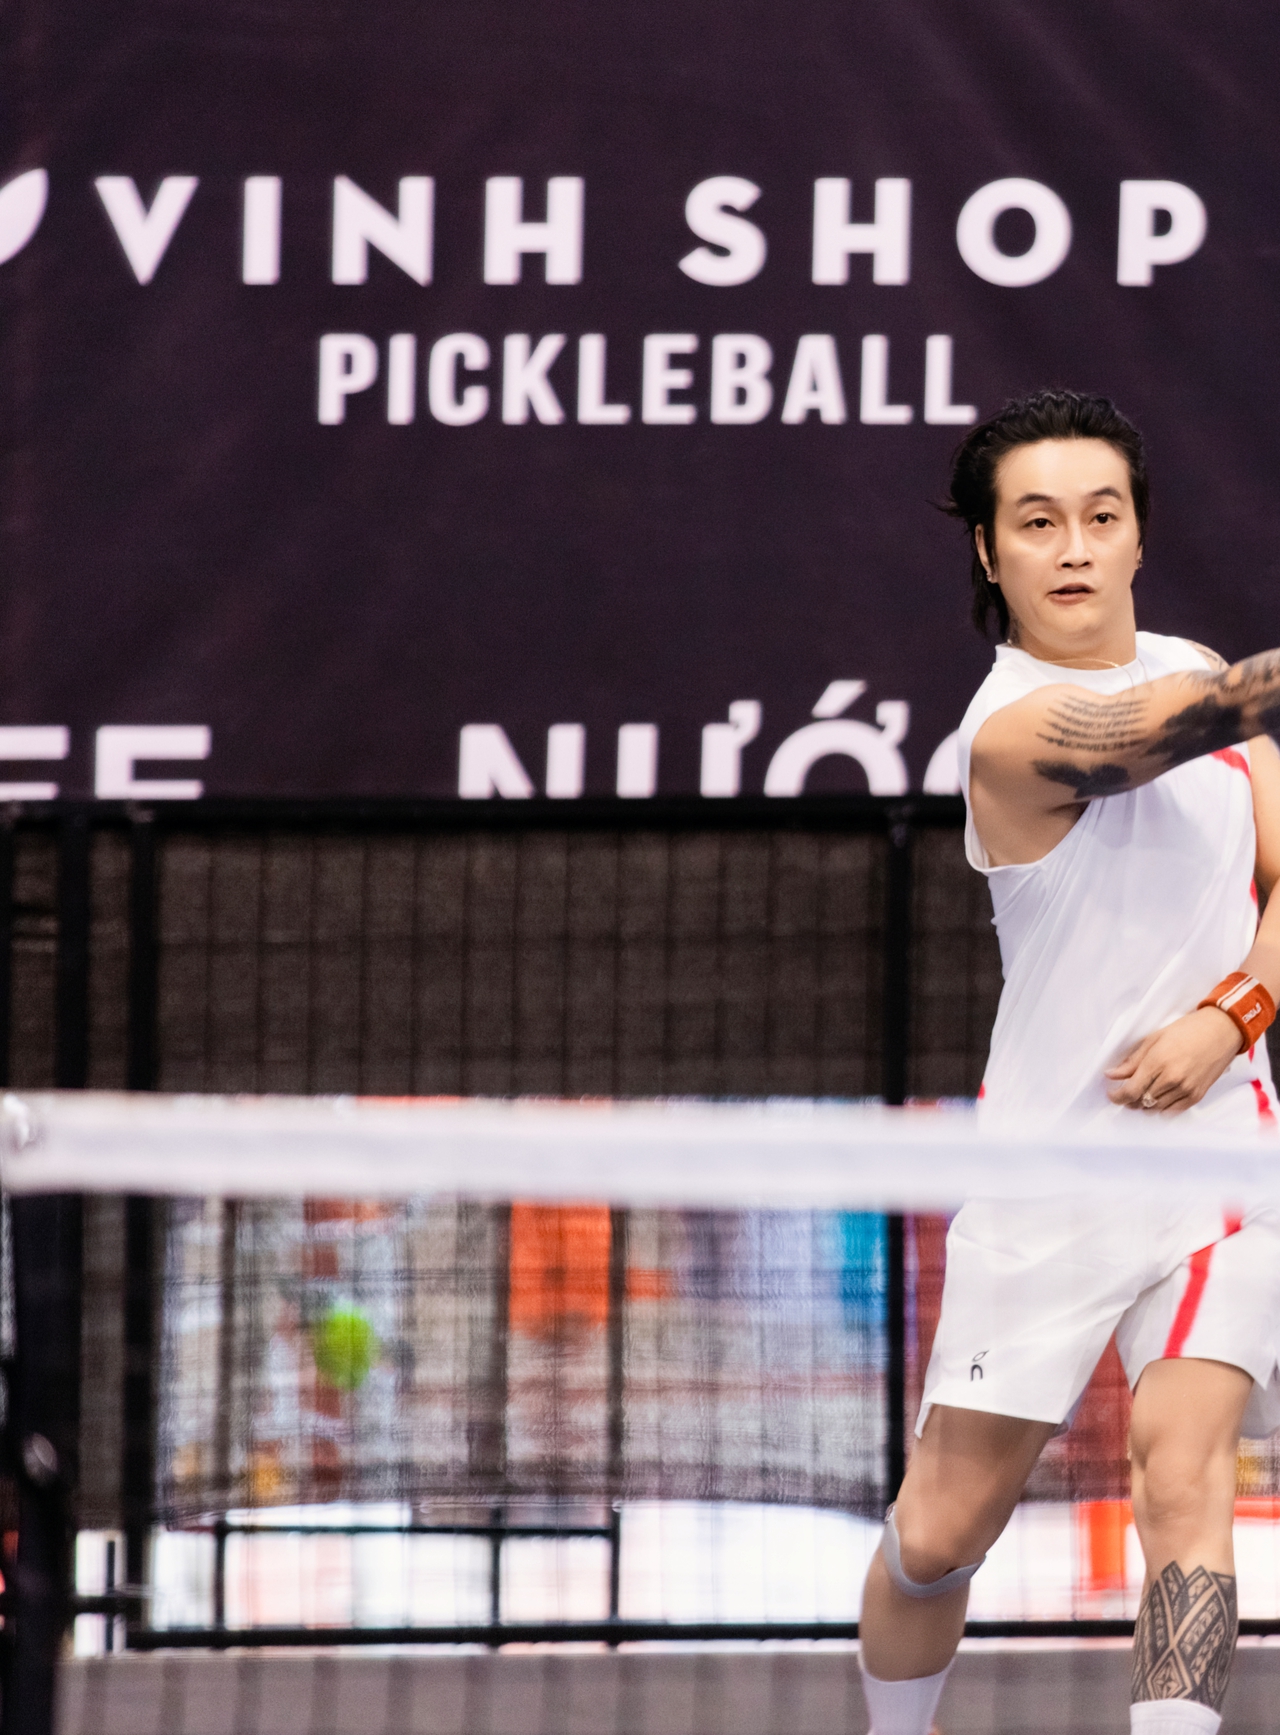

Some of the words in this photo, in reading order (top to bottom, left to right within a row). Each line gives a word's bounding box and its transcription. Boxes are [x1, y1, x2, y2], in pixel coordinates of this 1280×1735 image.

[94, 174, 585, 287] VINH
[678, 175, 1208, 288] SHOP
[317, 332, 979, 427] PICKLEBALL
